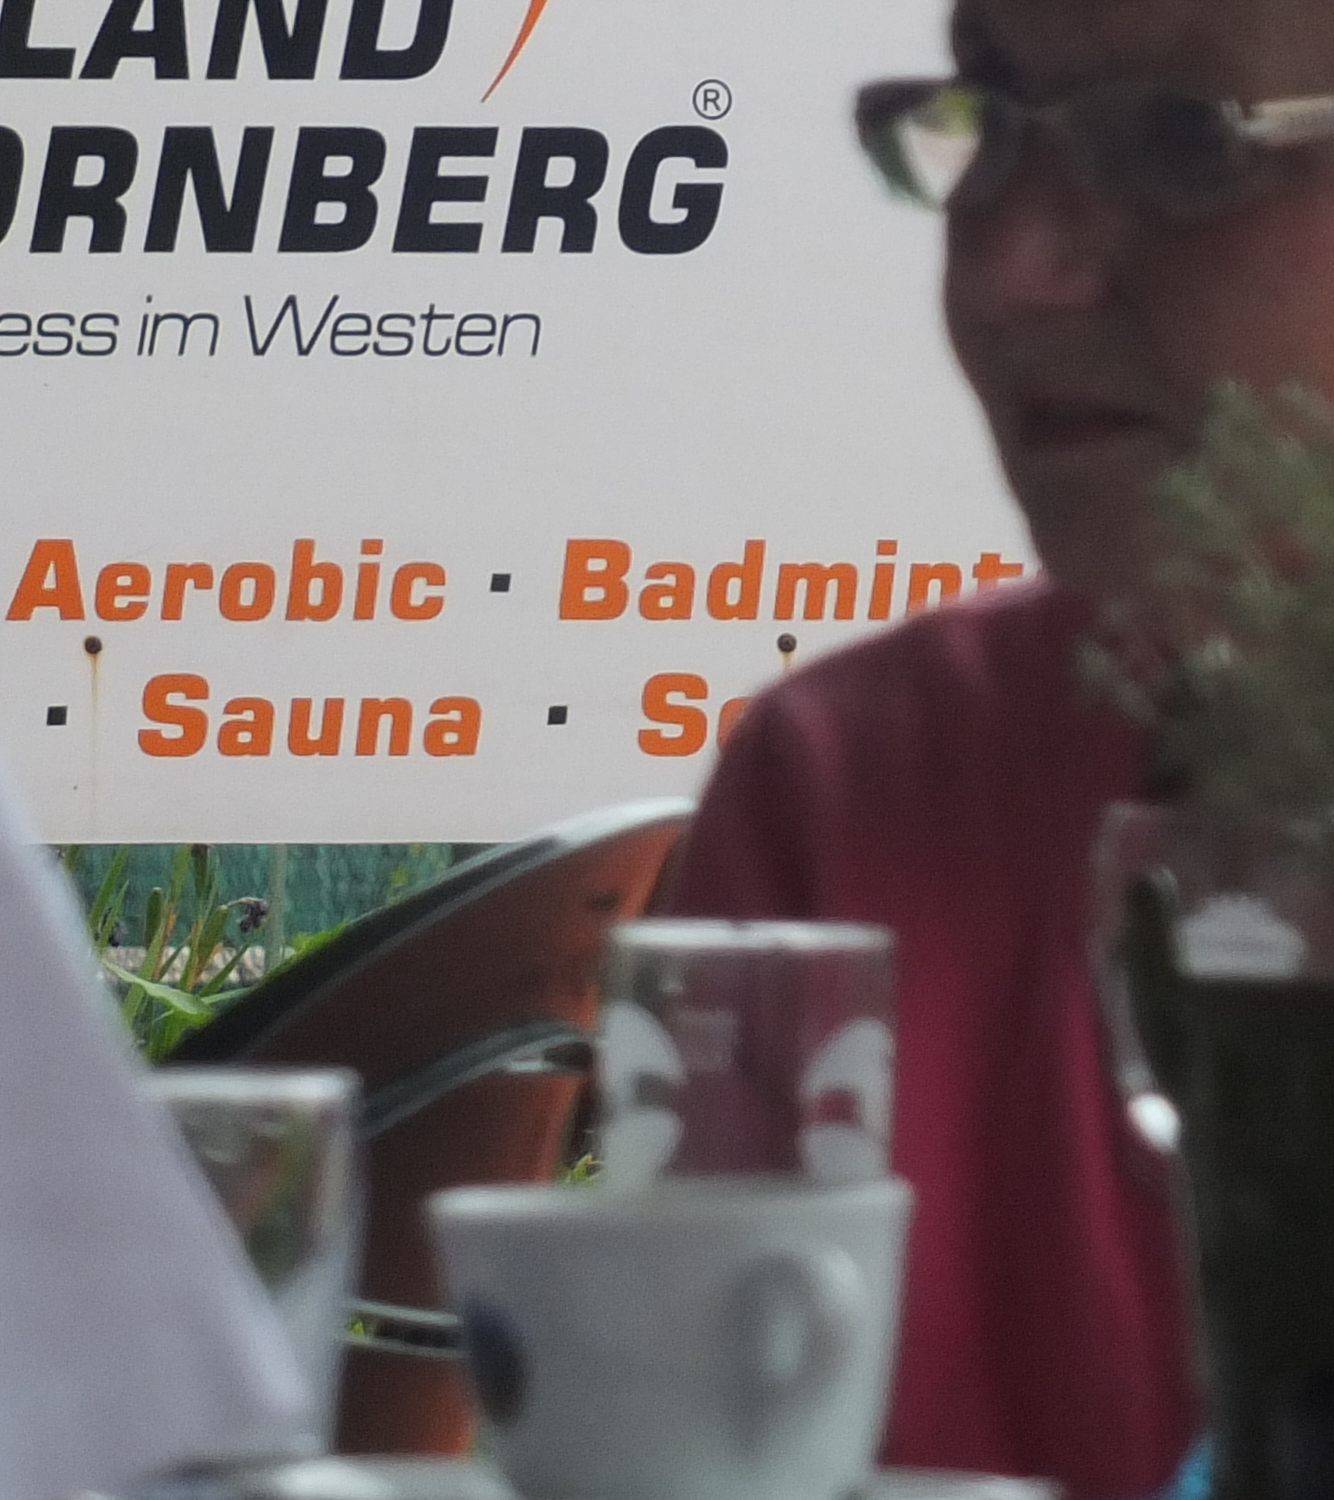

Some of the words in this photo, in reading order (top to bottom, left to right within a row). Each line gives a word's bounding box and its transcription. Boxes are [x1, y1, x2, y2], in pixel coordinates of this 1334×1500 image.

[136, 294, 220, 358] im
[243, 293, 542, 358] Westen
[5, 538, 448, 622] Aerobic
[137, 672, 483, 759] Sauna
